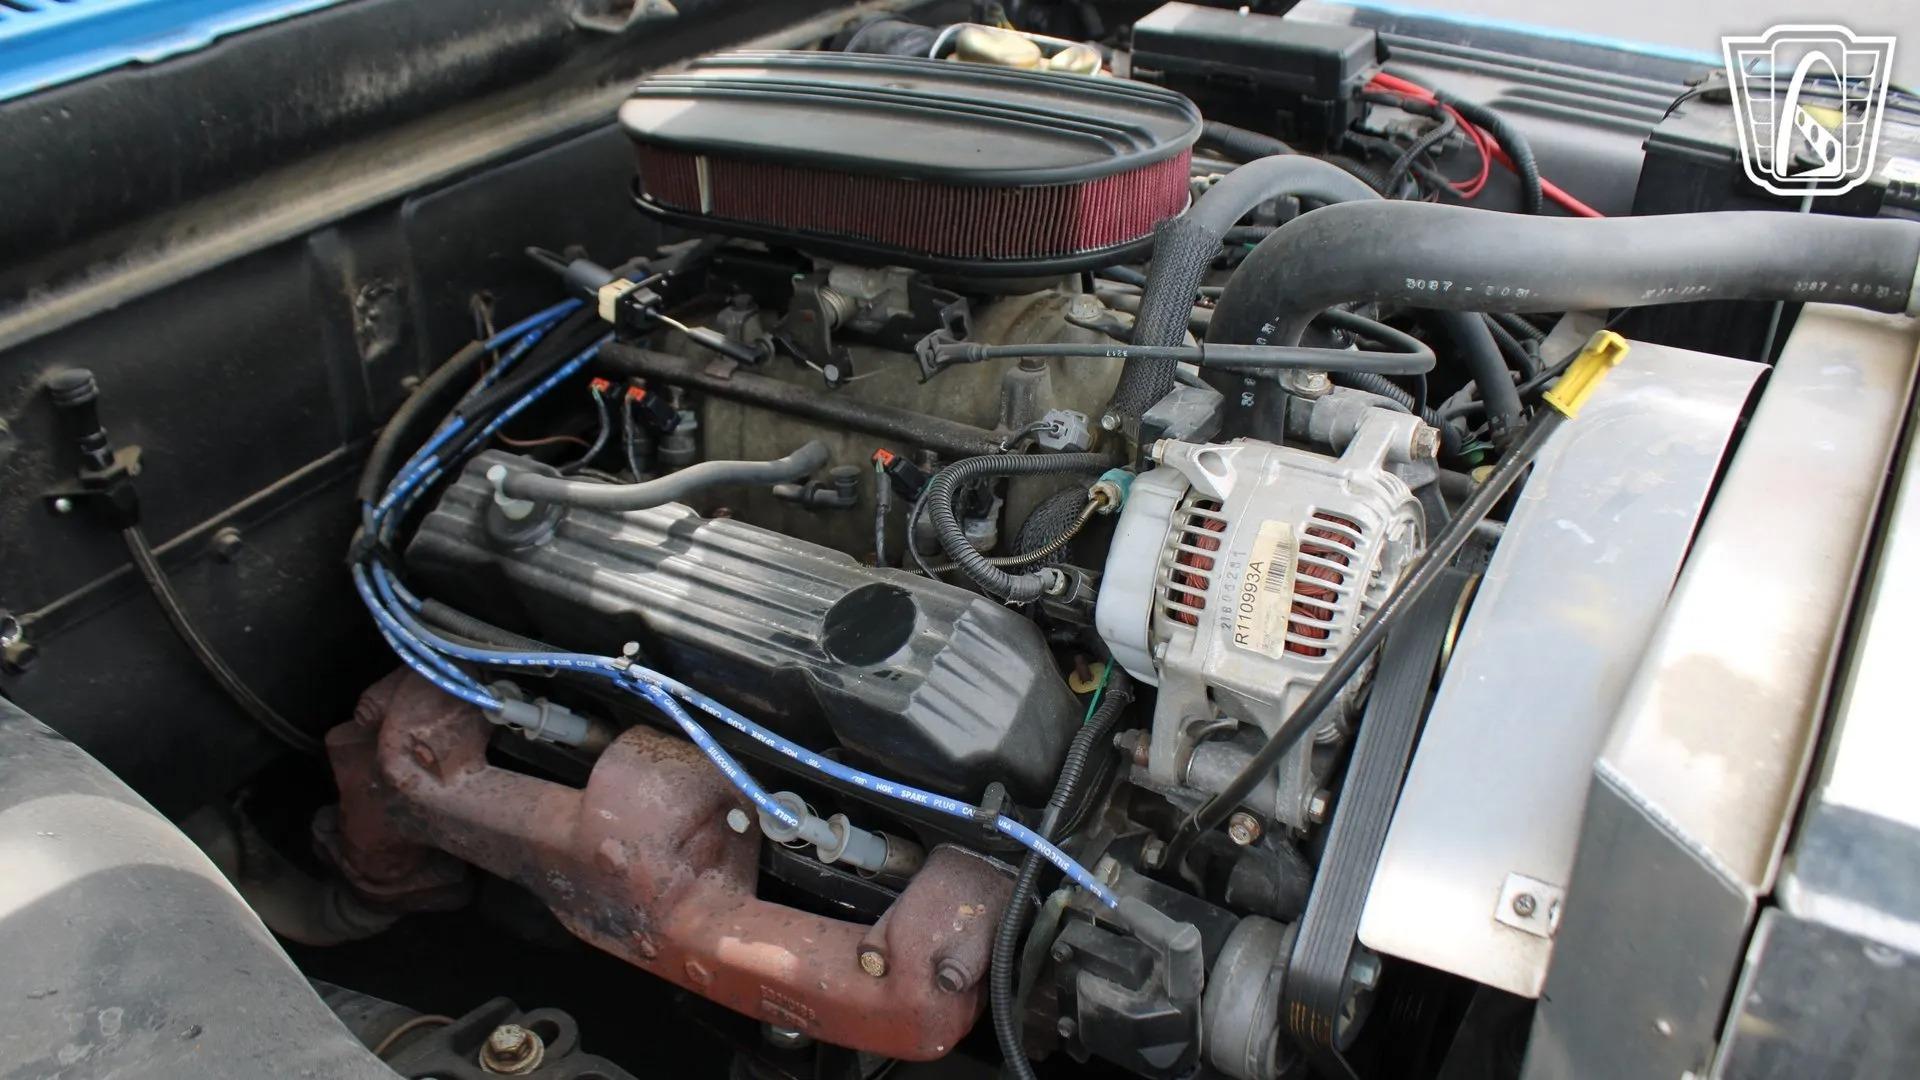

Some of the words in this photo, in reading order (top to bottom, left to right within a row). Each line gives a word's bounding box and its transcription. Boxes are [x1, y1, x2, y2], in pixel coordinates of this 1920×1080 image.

[1234, 560, 1265, 646] R110993A
[751, 730, 776, 747] SPARK
[707, 745, 737, 778] SILICONE
[901, 789, 928, 804] SPARK
[933, 799, 956, 811] PLUG
[775, 808, 799, 827] CABLE
[998, 820, 1011, 831] USA
[1033, 840, 1070, 871] SILICONE
